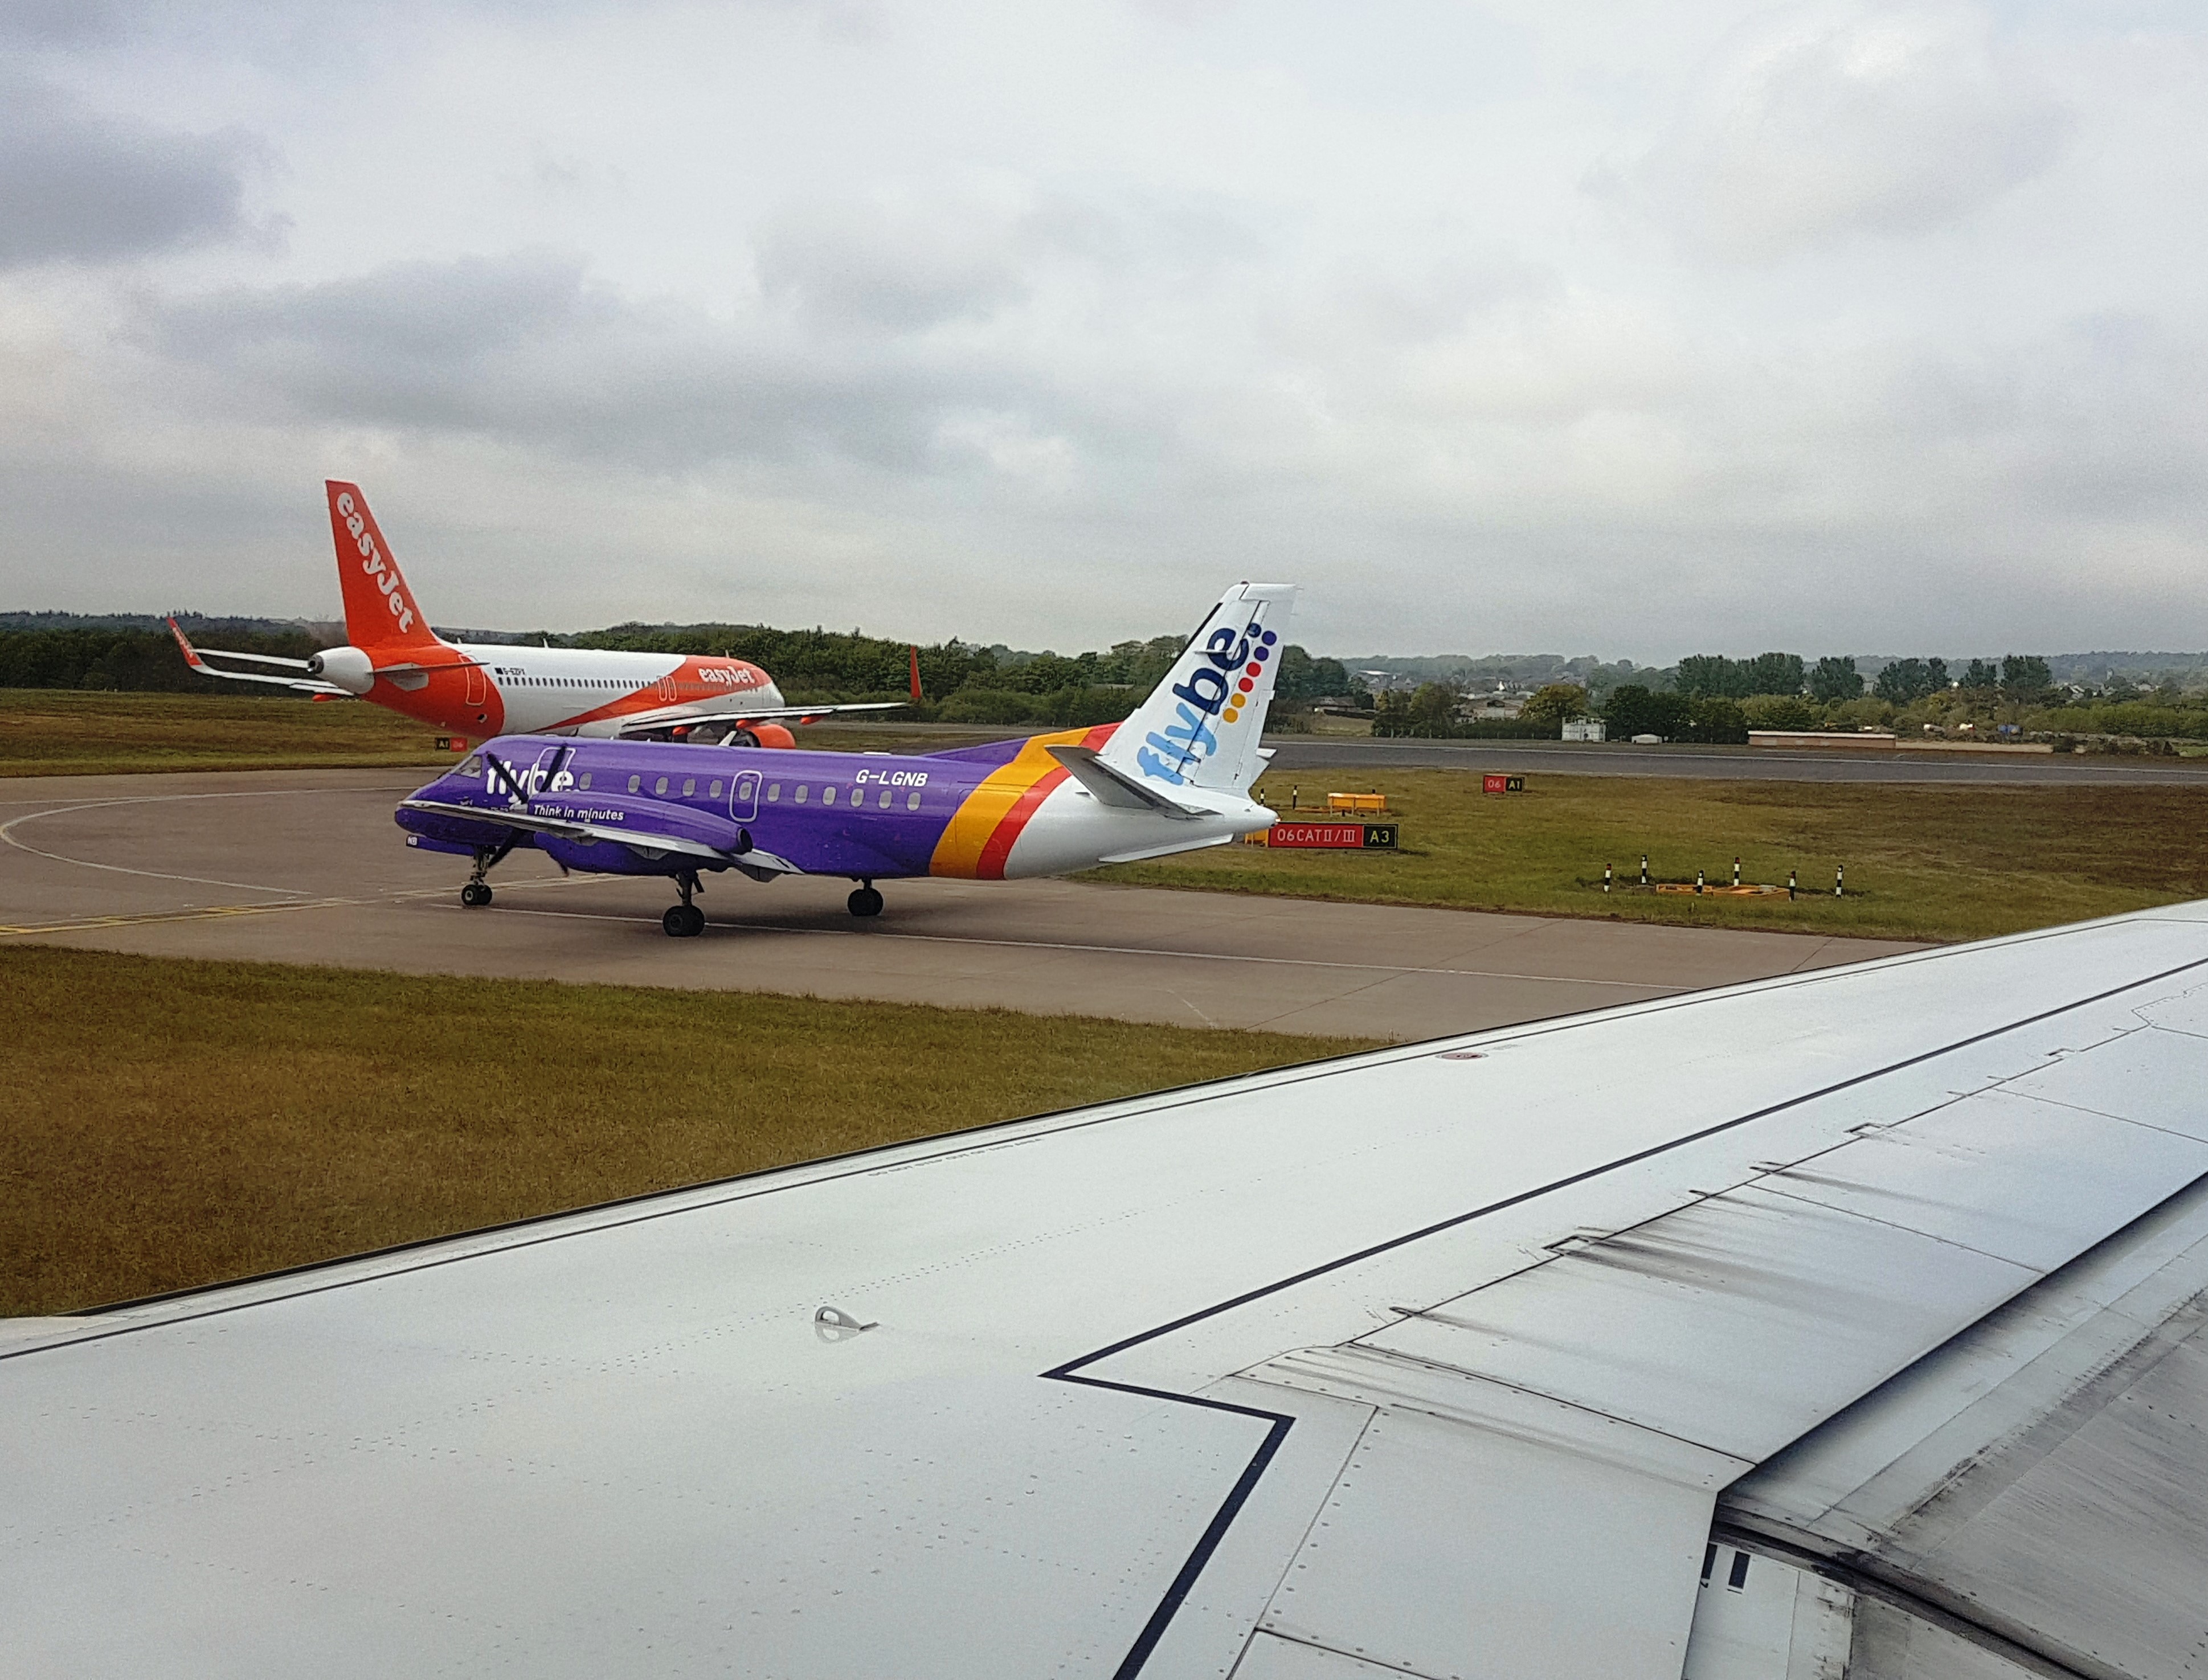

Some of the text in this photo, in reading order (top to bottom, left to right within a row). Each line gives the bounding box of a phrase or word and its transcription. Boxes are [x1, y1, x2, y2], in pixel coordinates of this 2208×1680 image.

[337, 492, 414, 633] easyJet
[698, 665, 755, 686] easyJet
[1136, 628, 1250, 786] flybe
[856, 769, 928, 786] G-LGNB
[1488, 780, 1520, 789] 06 A1
[534, 805, 624, 821] Think in minutes
[1369, 830, 1389, 843] A3
